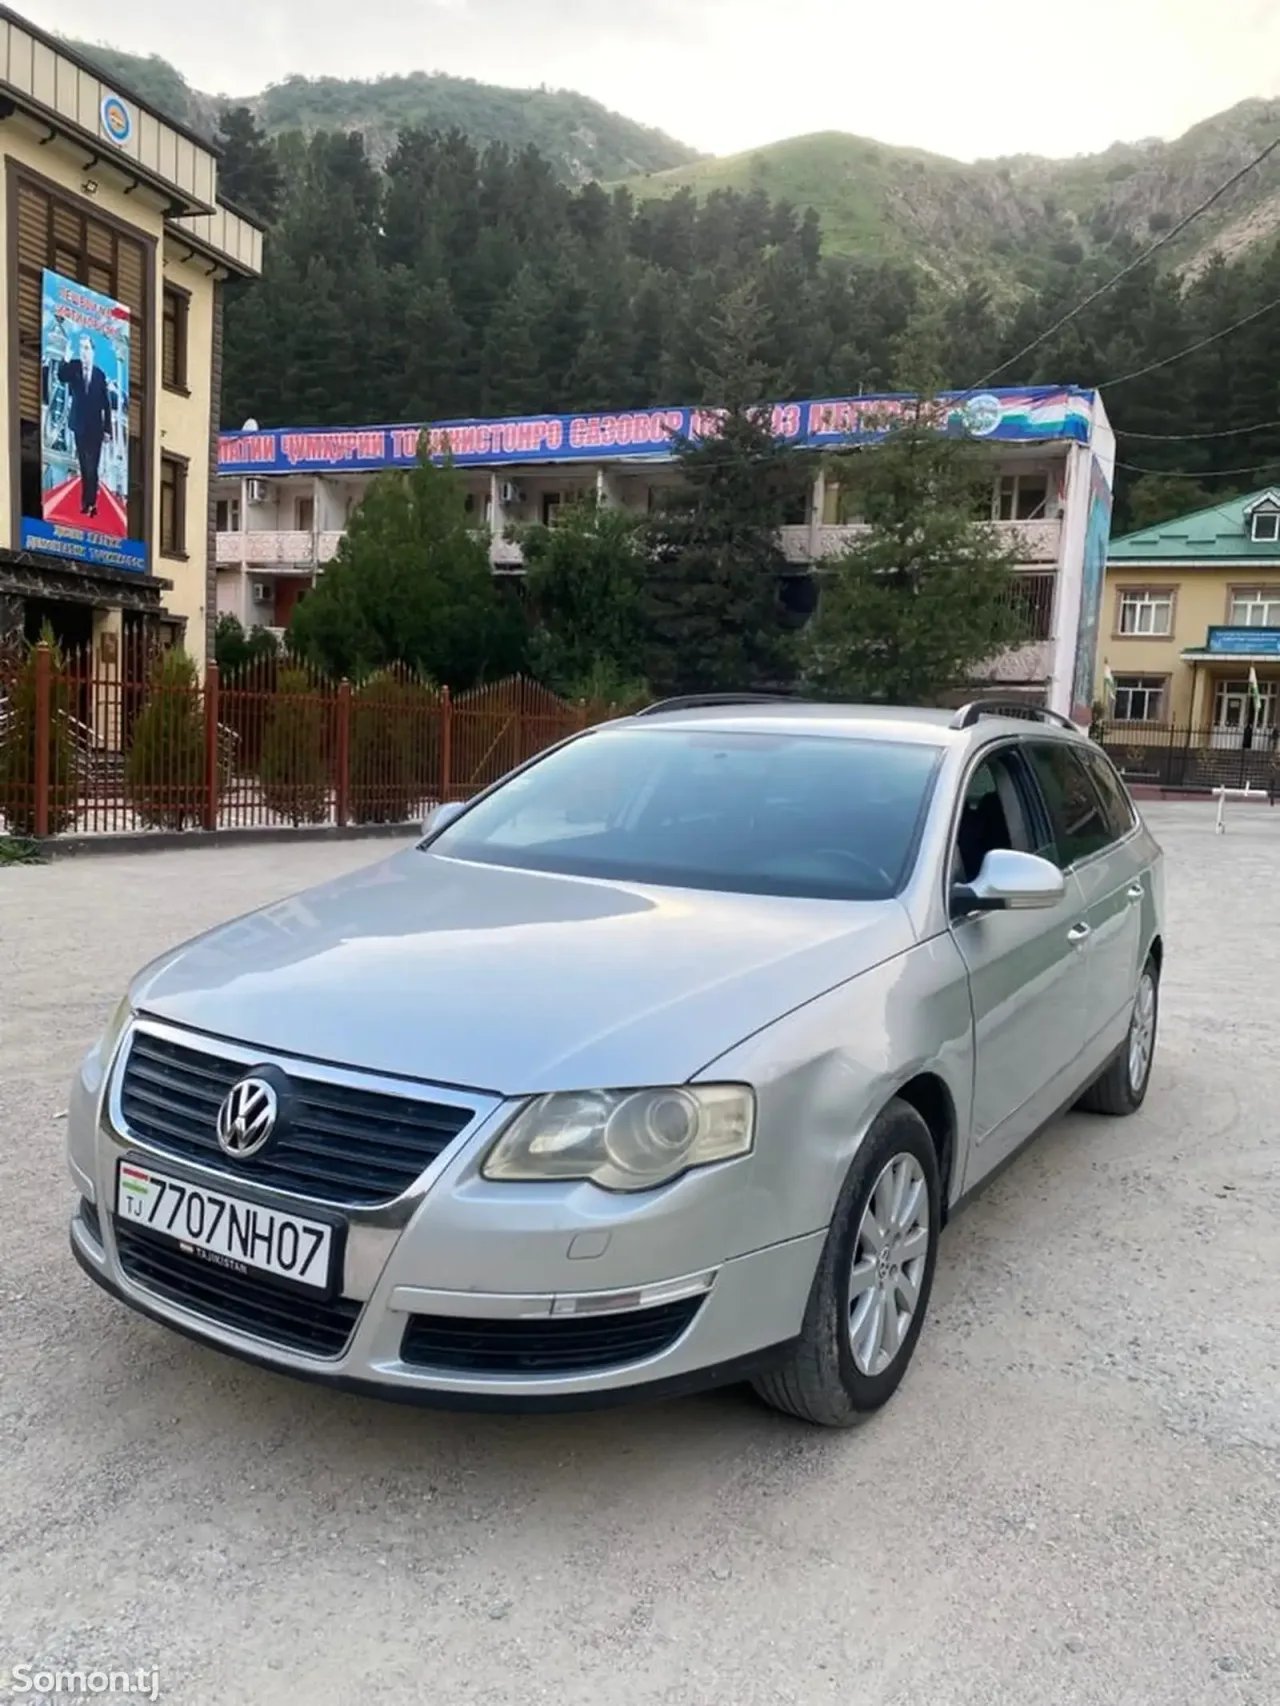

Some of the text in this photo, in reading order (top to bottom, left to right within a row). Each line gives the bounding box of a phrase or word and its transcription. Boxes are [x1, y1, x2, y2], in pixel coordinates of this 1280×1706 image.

[569, 411, 684, 449] САЗОВОР
[126, 1195, 143, 1217] TJ
[148, 1178, 325, 1276] 7707NH07
[196, 1246, 248, 1274] TAJIKISTAN
